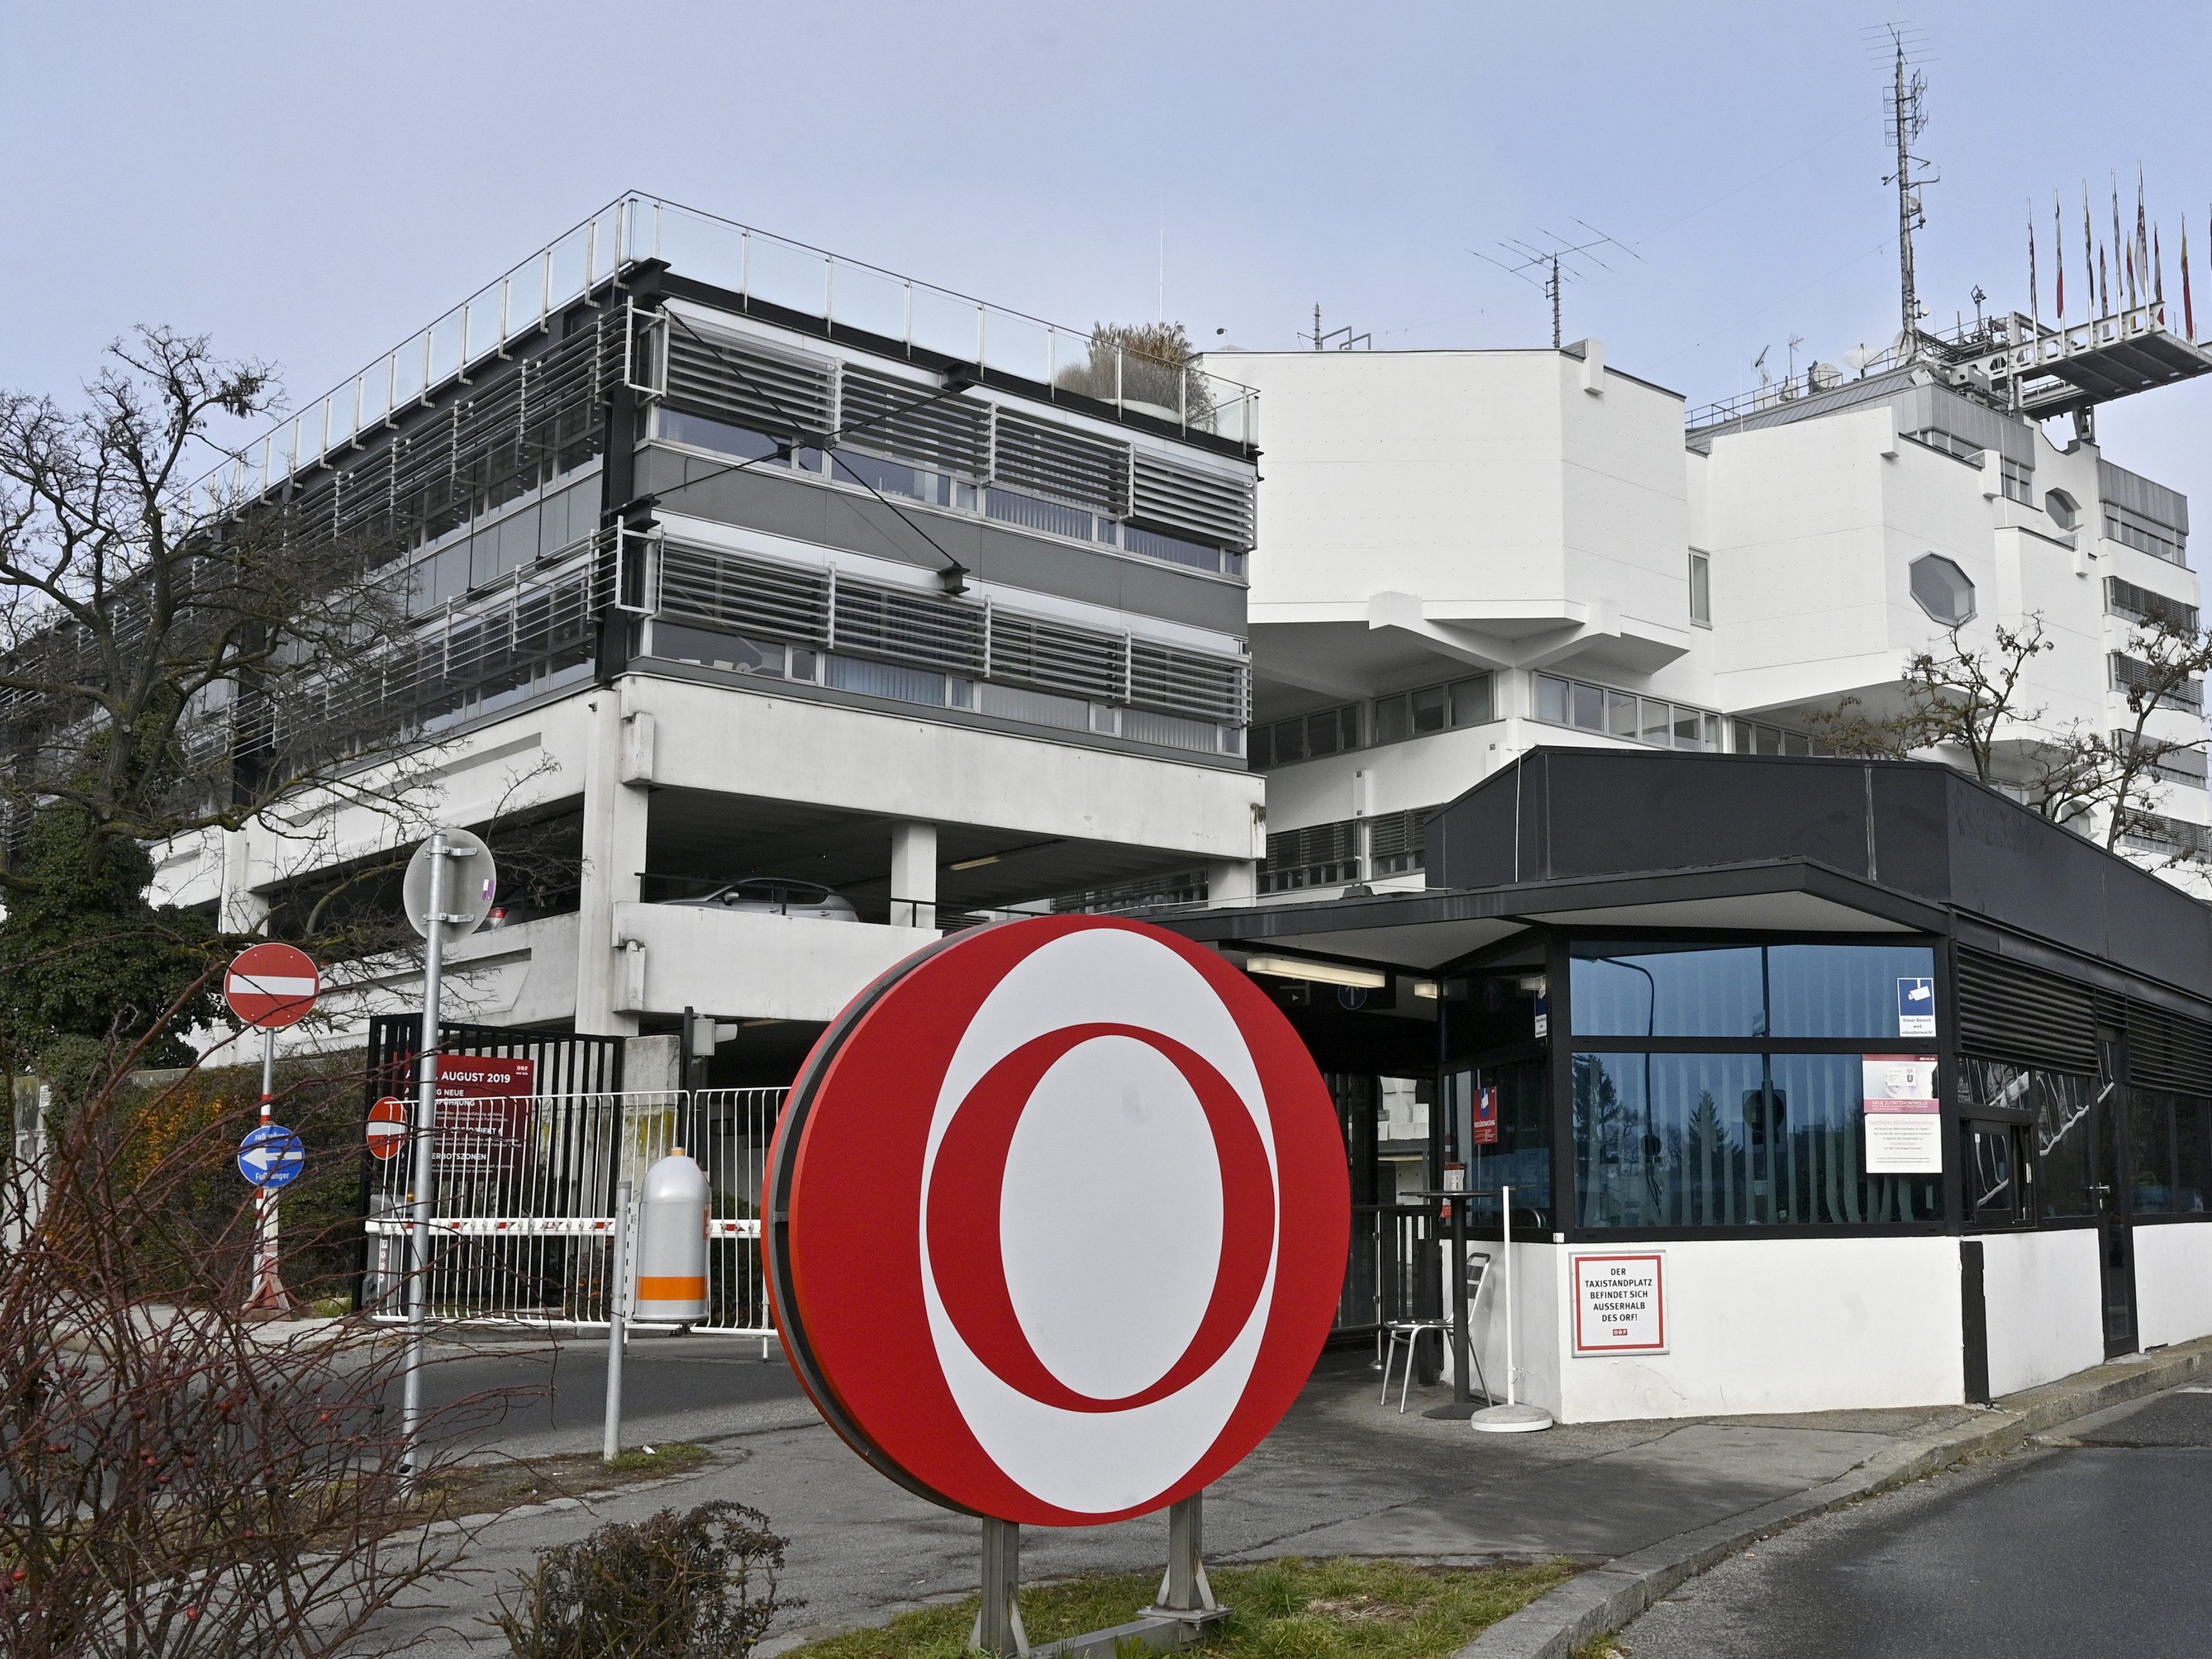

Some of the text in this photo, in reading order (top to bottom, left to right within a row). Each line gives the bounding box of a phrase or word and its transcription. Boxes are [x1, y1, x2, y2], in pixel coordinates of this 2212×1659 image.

[441, 1072, 485, 1082] AUGUST
[487, 1073, 511, 1083] 2019
[1585, 1278, 1653, 1287] TAXISTANDPLATZ
[1590, 1290, 1648, 1299] BEFINDET SICH
[1593, 1302, 1646, 1311] AUSSERHALB
[1602, 1313, 1637, 1322] DES ORF!
